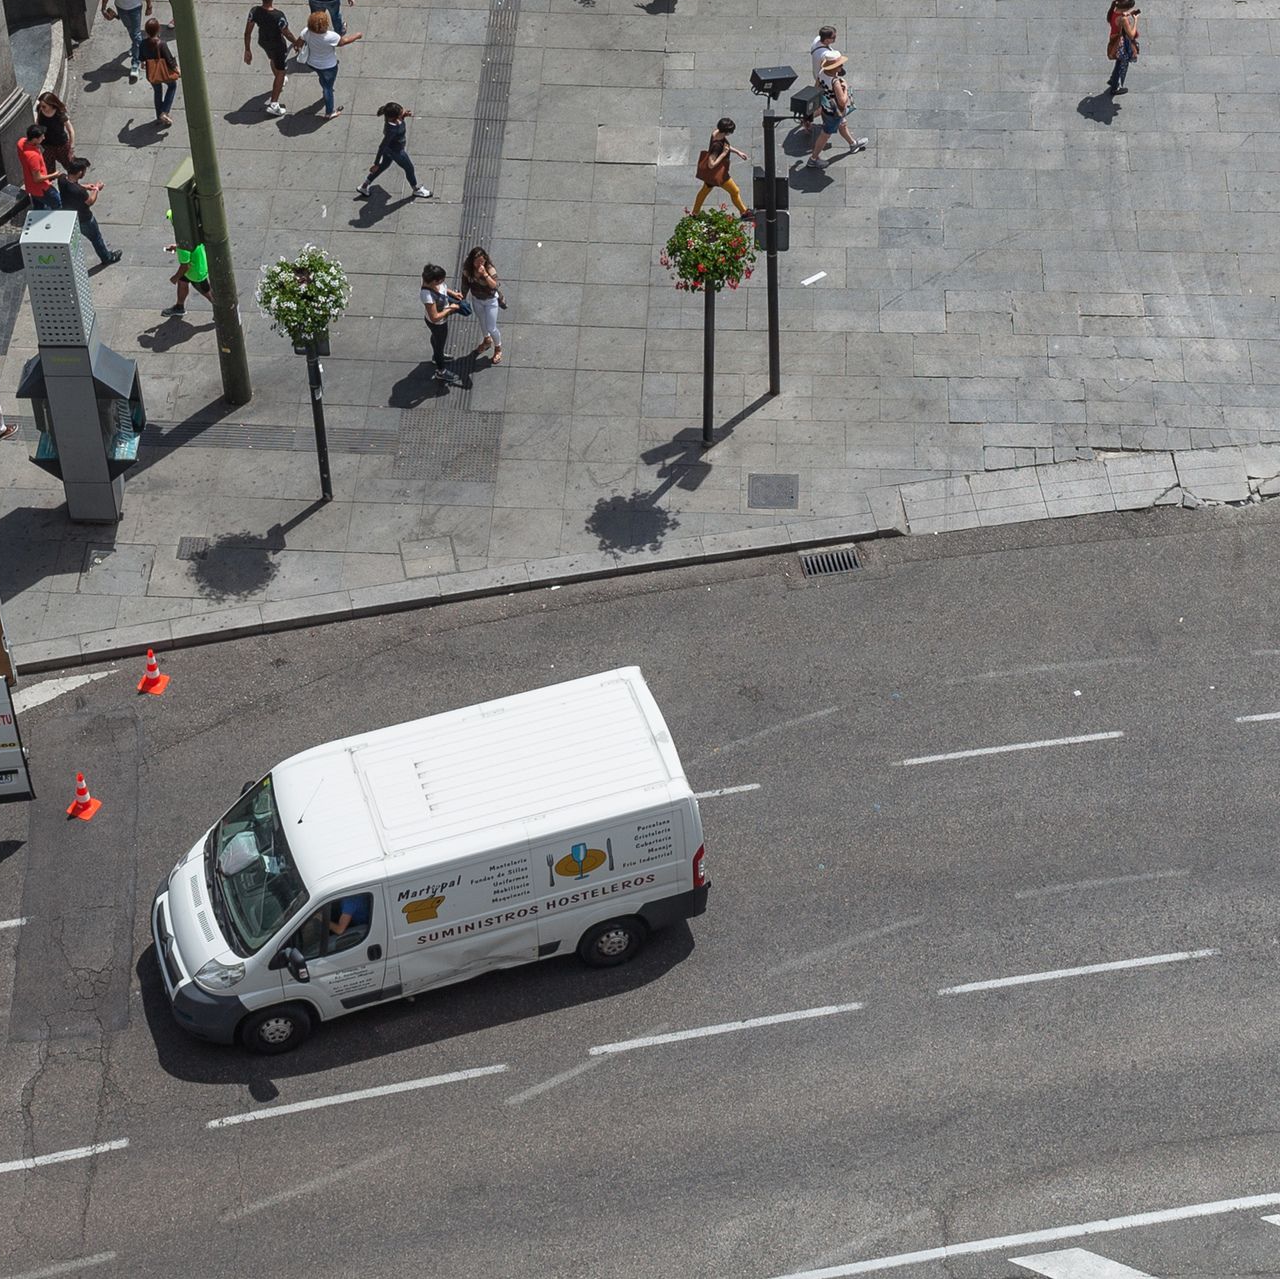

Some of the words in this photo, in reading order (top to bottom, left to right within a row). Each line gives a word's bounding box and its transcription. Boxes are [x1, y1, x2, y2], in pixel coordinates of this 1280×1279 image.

[0, 714, 13, 726] TU
[417, 905, 539, 945] SUMINISTROS
[546, 873, 656, 910] HOSTELEROS
